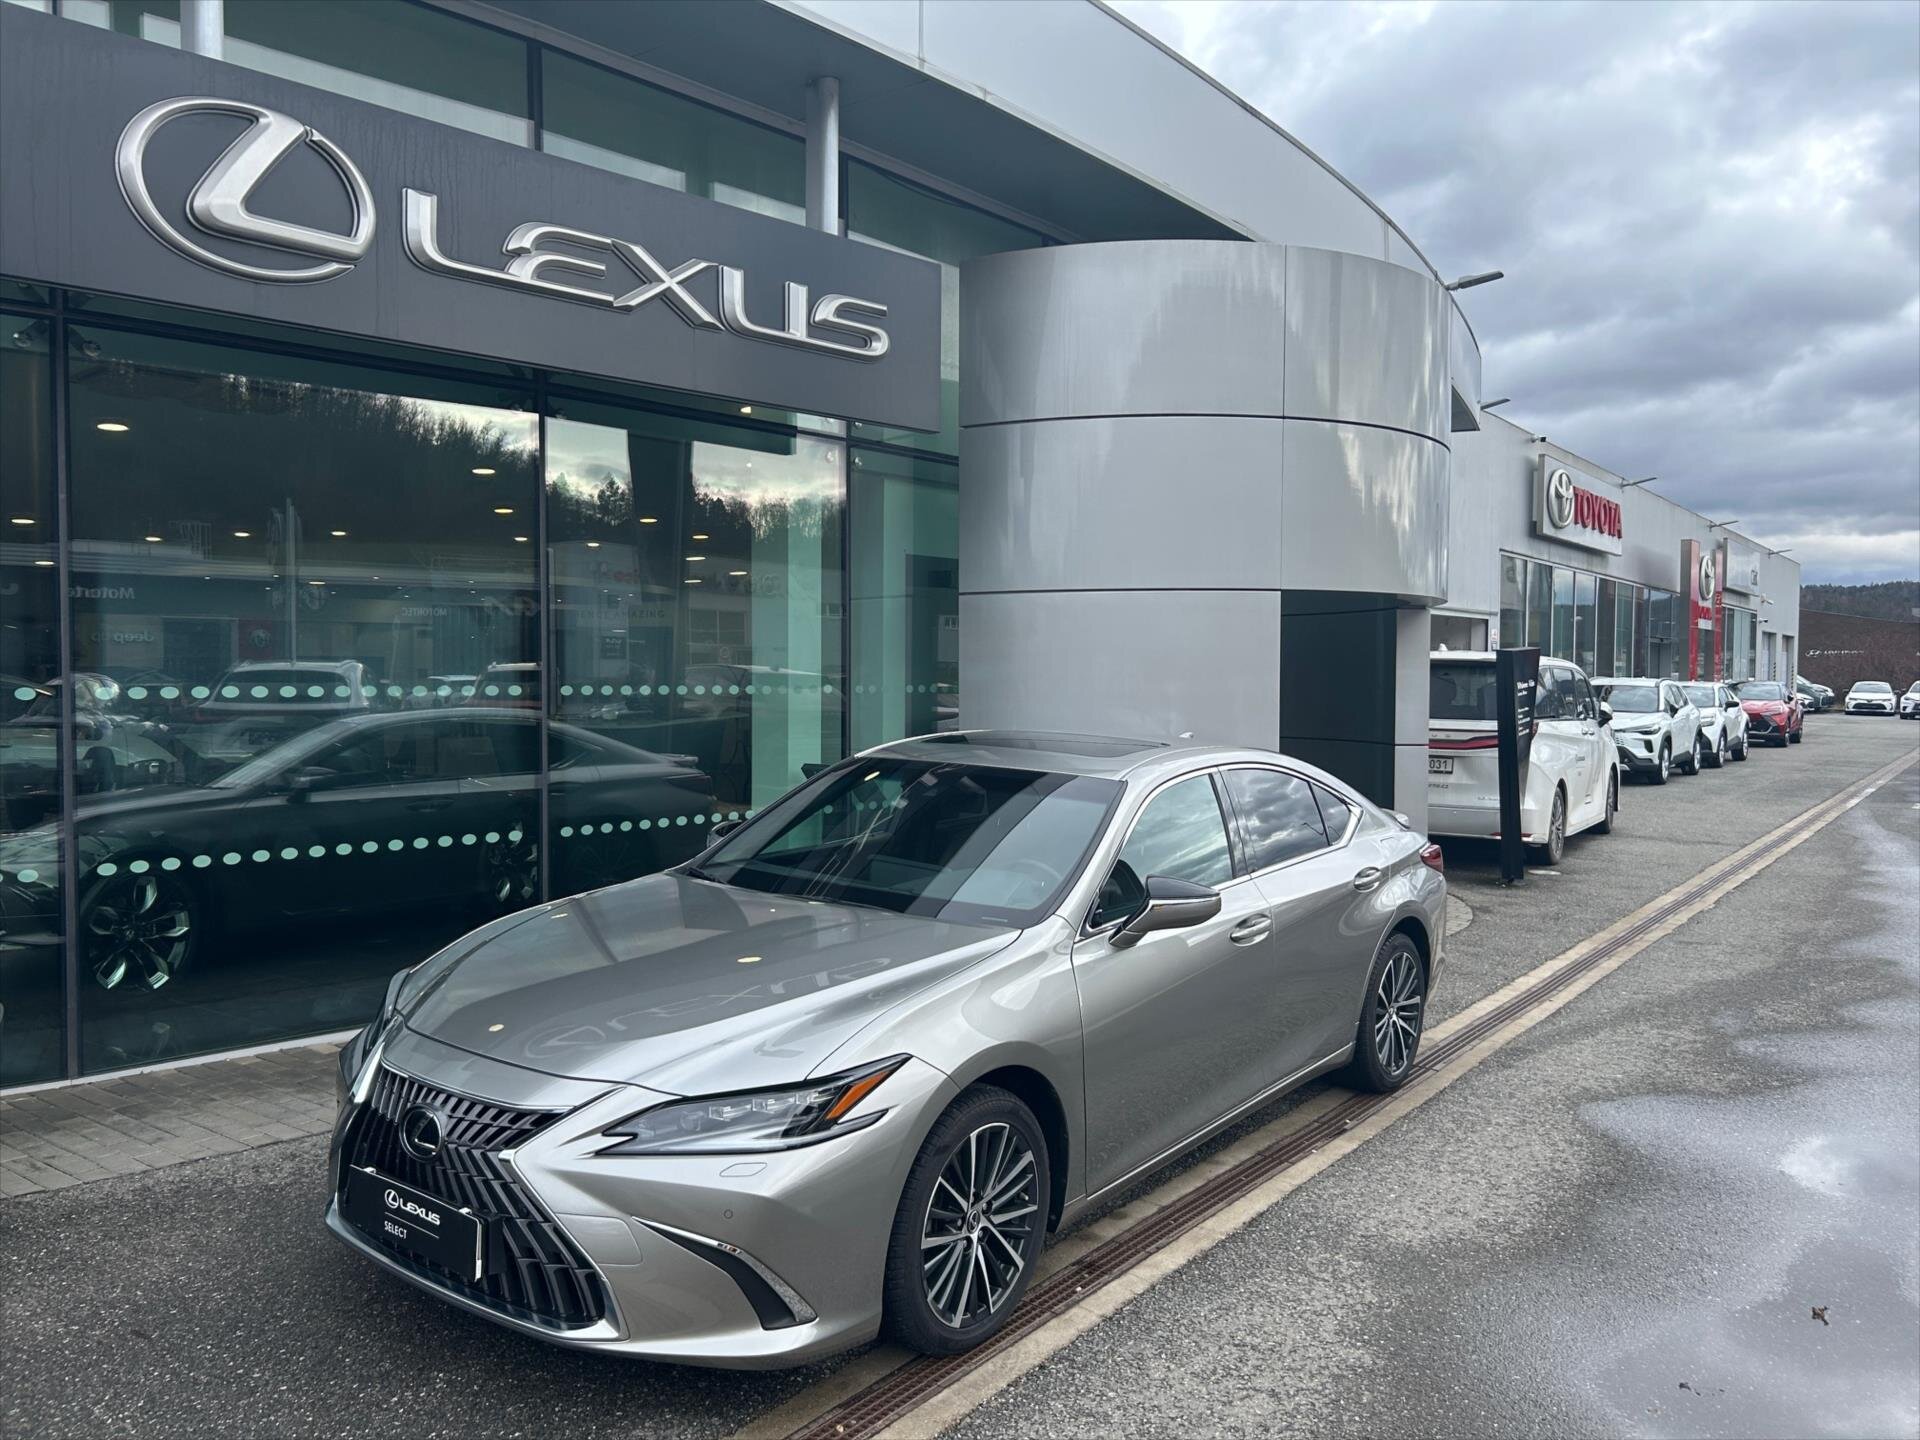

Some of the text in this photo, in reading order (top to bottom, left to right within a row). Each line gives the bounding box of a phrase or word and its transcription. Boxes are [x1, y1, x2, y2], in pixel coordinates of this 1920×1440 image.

[400, 187, 893, 363] LEXUS
[1572, 486, 1623, 539] TOYOTA
[1429, 759, 1448, 769] 031
[399, 1197, 442, 1226] LEXUS
[384, 1220, 408, 1240] SELECT
